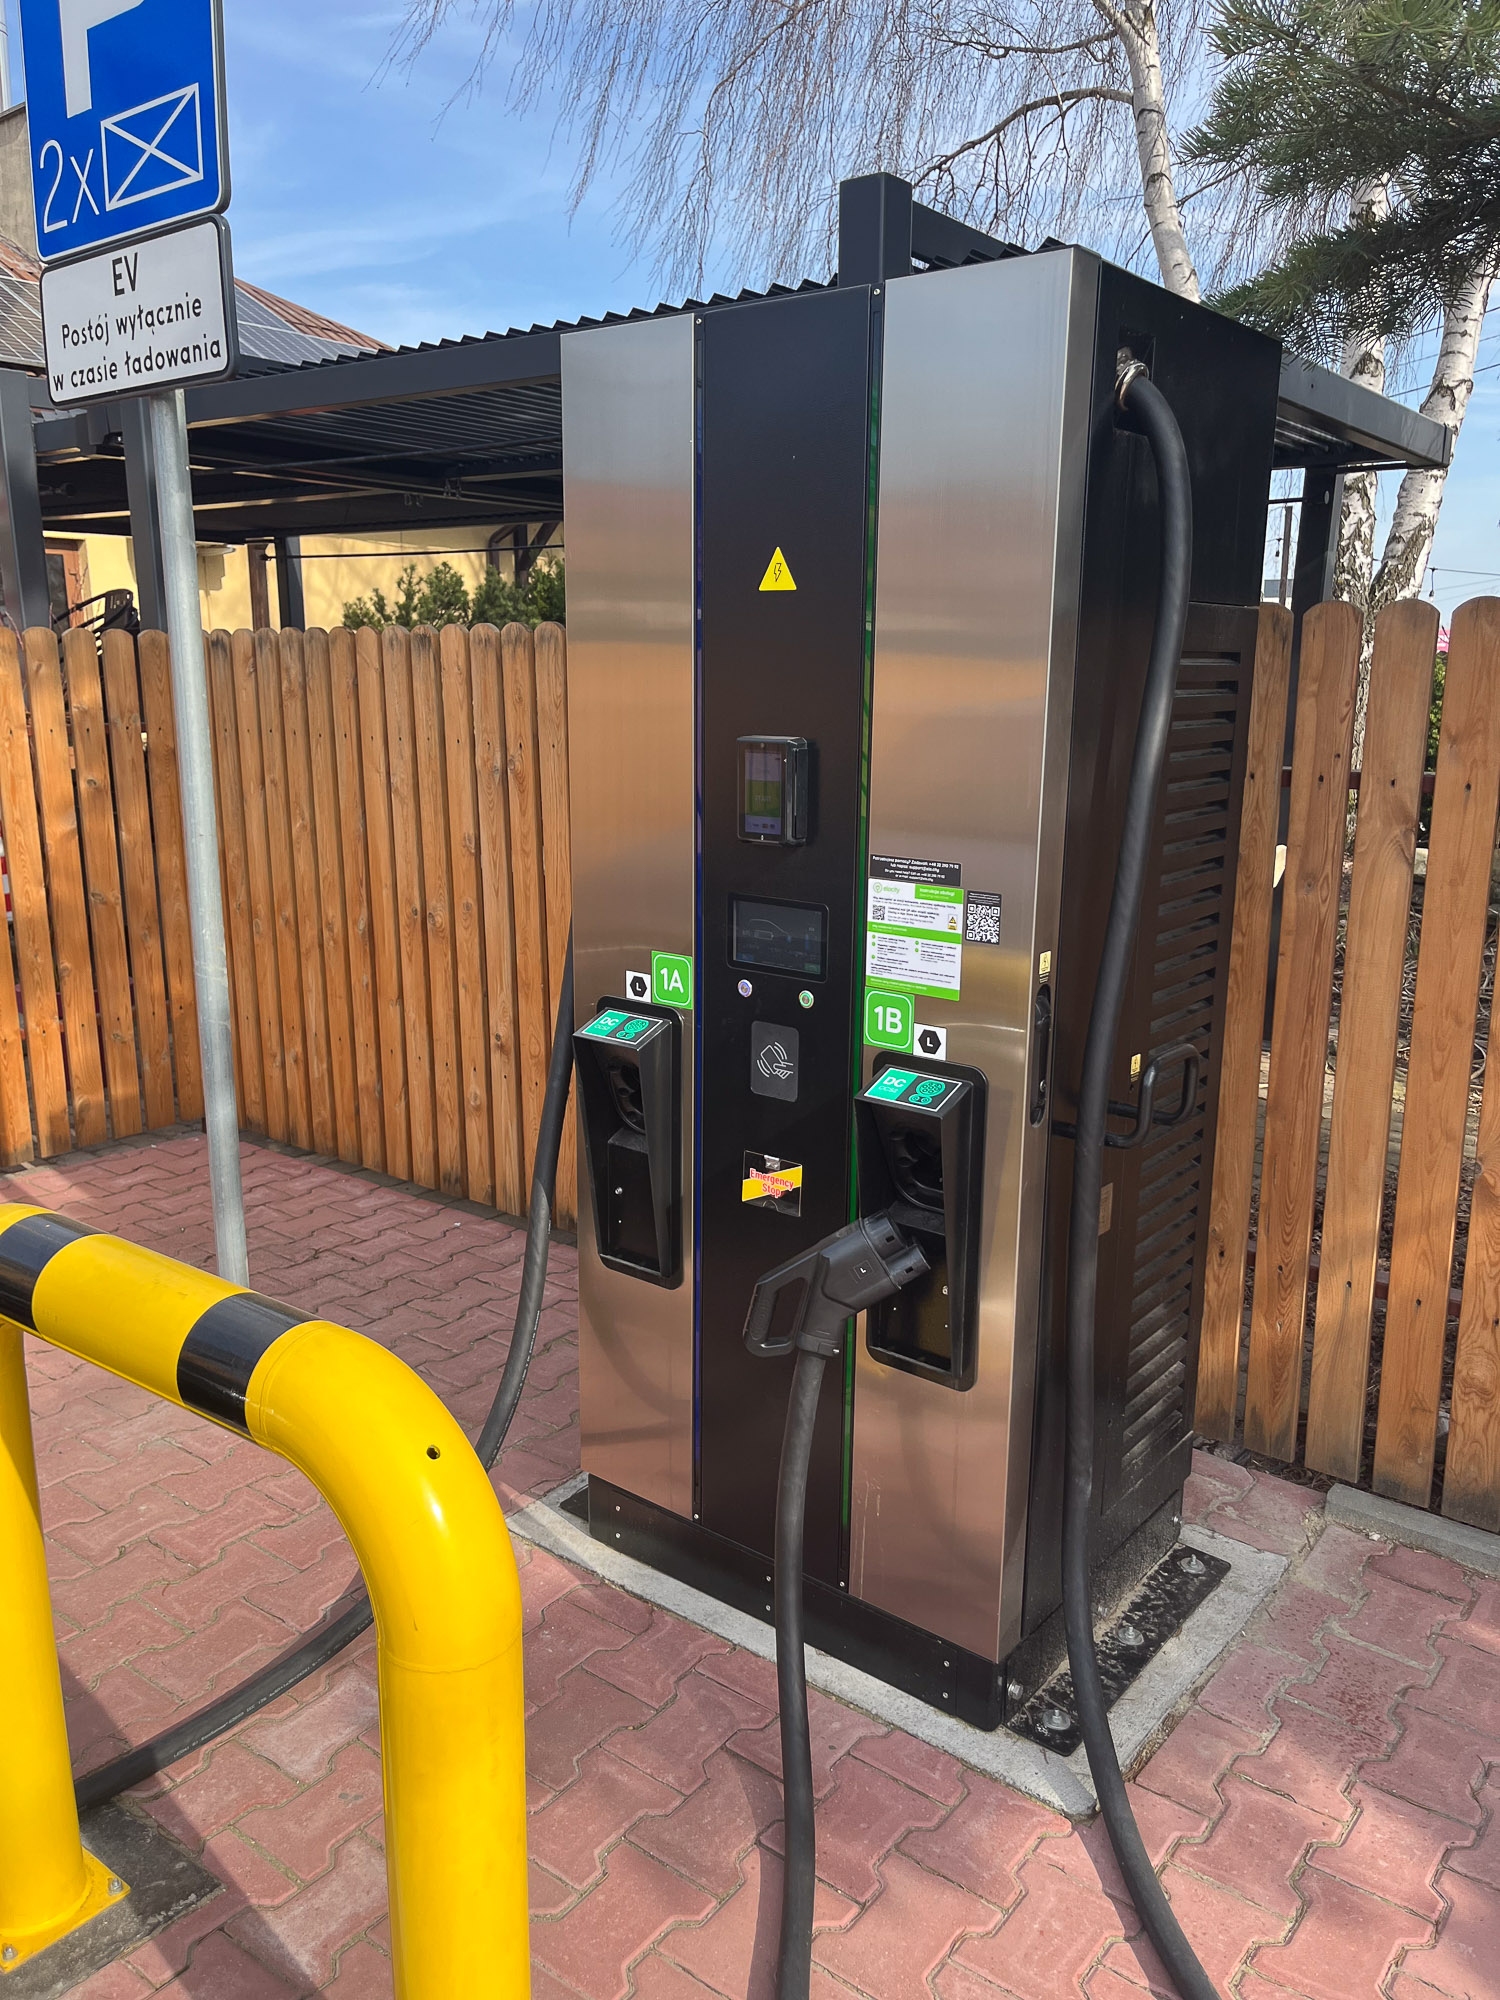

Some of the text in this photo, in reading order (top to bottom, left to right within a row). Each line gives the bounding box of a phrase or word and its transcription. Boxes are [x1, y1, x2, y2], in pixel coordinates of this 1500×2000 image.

[112, 252, 138, 296] EV
[61, 292, 202, 349] Postój wyłącznie
[53, 334, 222, 392] w czasie ładowania
[636, 982, 642, 991] L
[660, 968, 684, 993] 1A
[600, 1017, 619, 1026] DC
[873, 1005, 903, 1034] 1B
[926, 1037, 933, 1047] L
[882, 1077, 906, 1087] DC
[750, 1167, 794, 1191] Emergency
[762, 1183, 781, 1198] Stop
